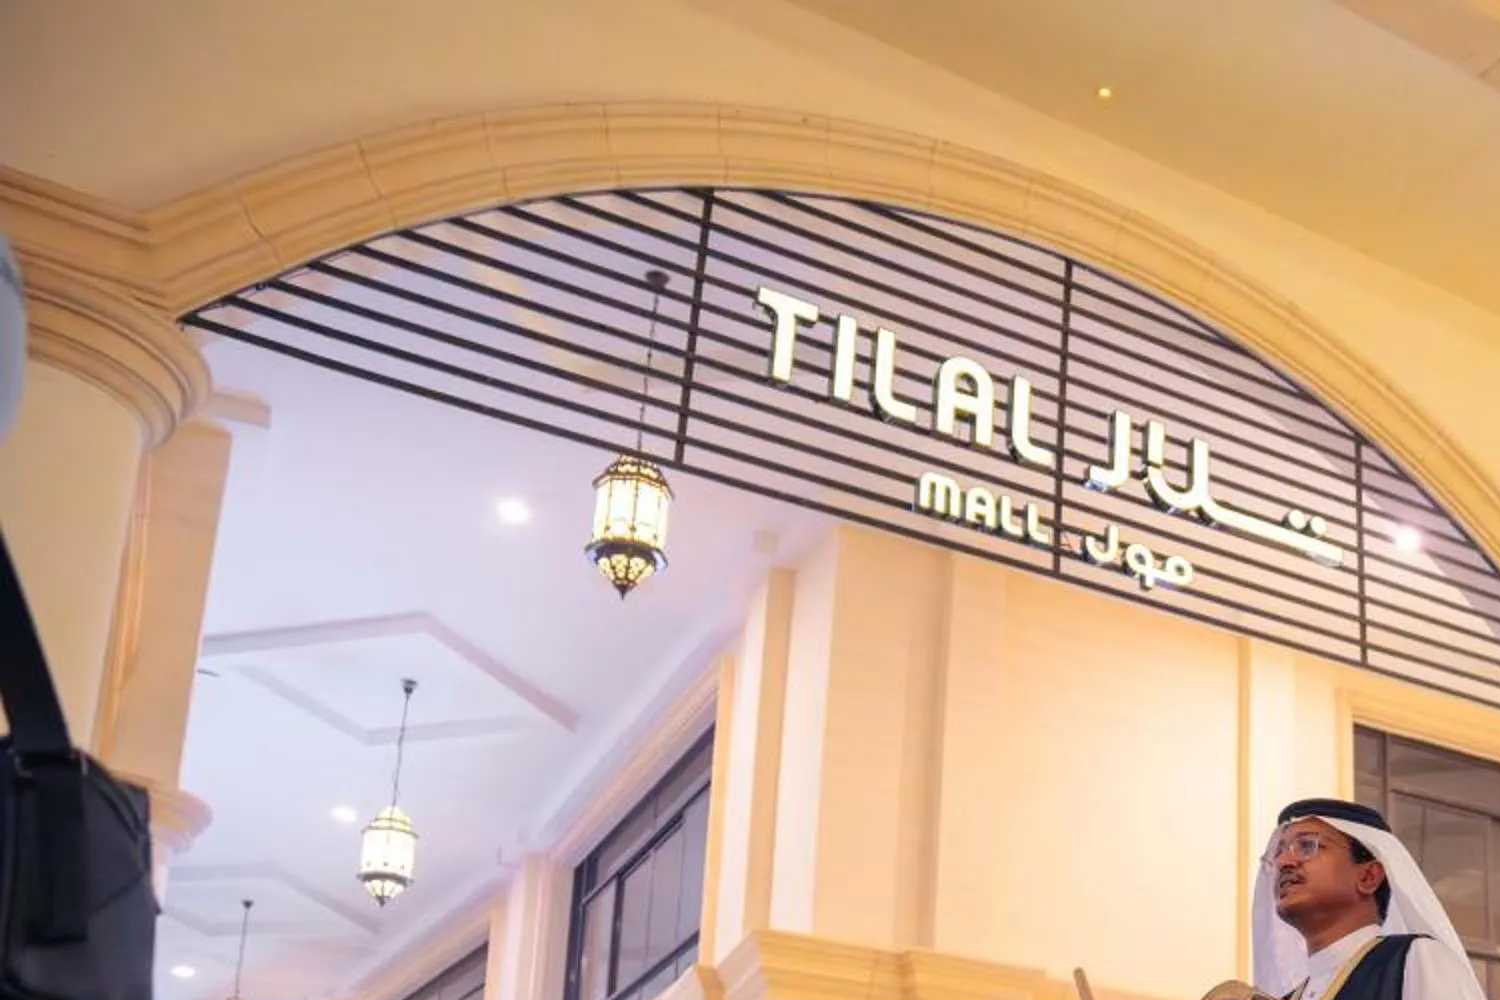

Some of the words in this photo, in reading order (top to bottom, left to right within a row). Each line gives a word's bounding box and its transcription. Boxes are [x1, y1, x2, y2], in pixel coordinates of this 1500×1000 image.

[752, 286, 1055, 466] TILAL
[916, 471, 1051, 544] MALL
[1085, 409, 1344, 565] تلال
[1083, 523, 1195, 589] مول
